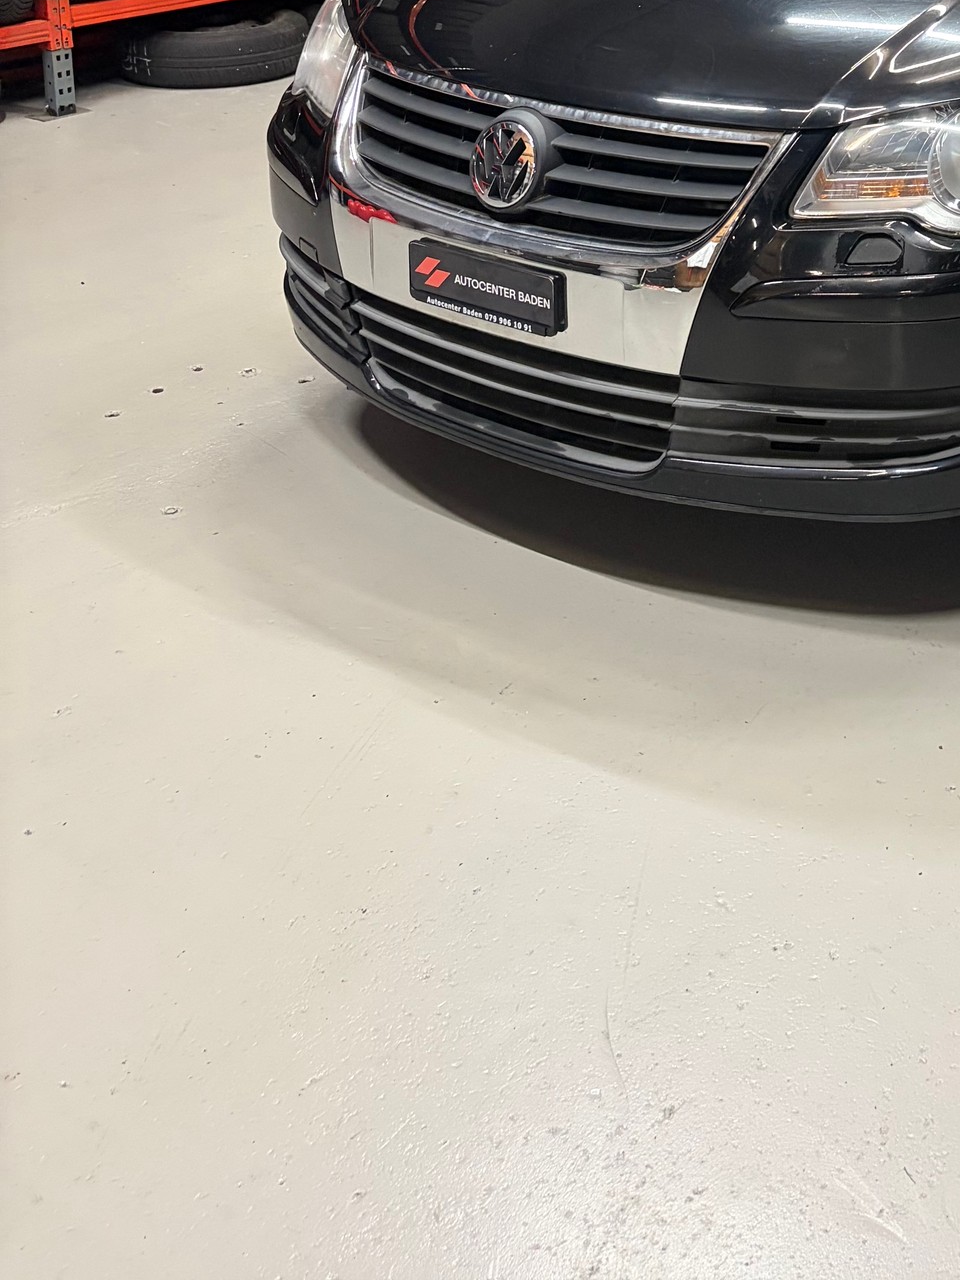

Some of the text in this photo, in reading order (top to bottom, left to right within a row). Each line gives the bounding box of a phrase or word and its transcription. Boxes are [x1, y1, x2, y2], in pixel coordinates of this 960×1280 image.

[454, 274, 551, 309] AUTOCENTER BADEN
[426, 296, 532, 333] Autocenter Baden 079 906 10 91
